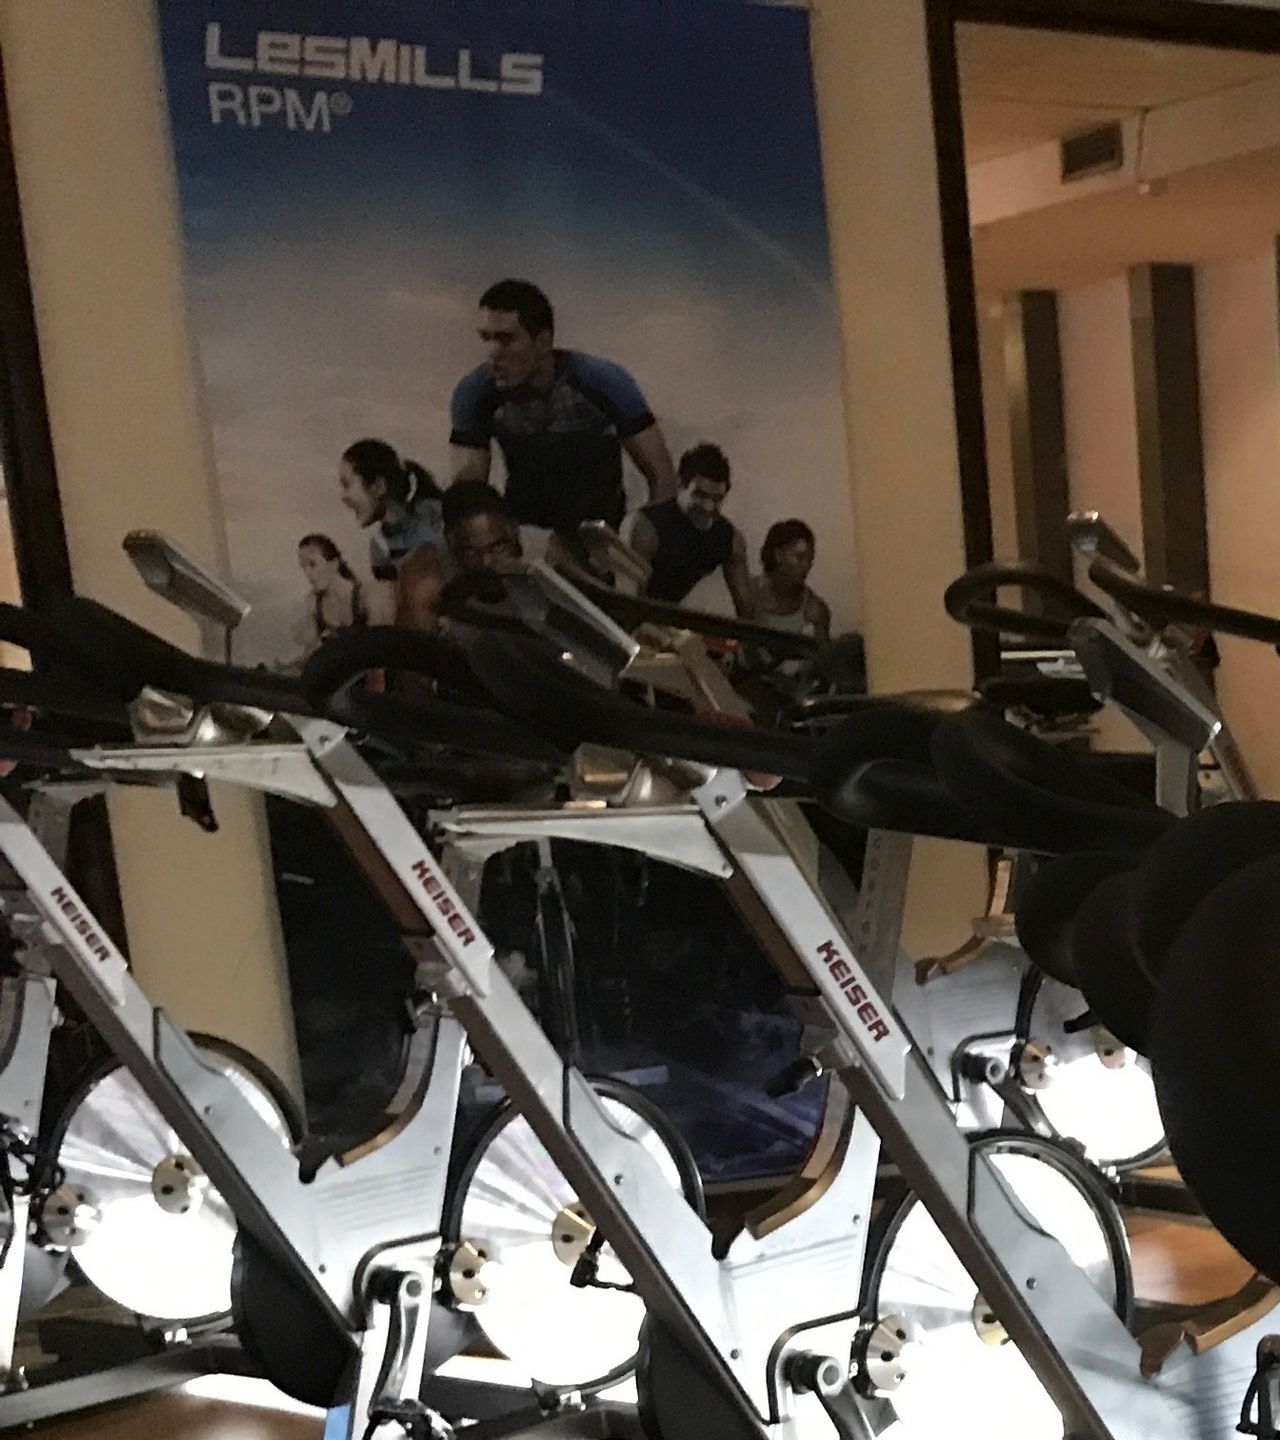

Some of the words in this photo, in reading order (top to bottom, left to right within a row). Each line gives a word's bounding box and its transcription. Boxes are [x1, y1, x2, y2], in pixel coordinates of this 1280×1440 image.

[51, 886, 110, 961] KEISER
[412, 860, 475, 946] KEISER
[816, 939, 889, 1042] KEISER
